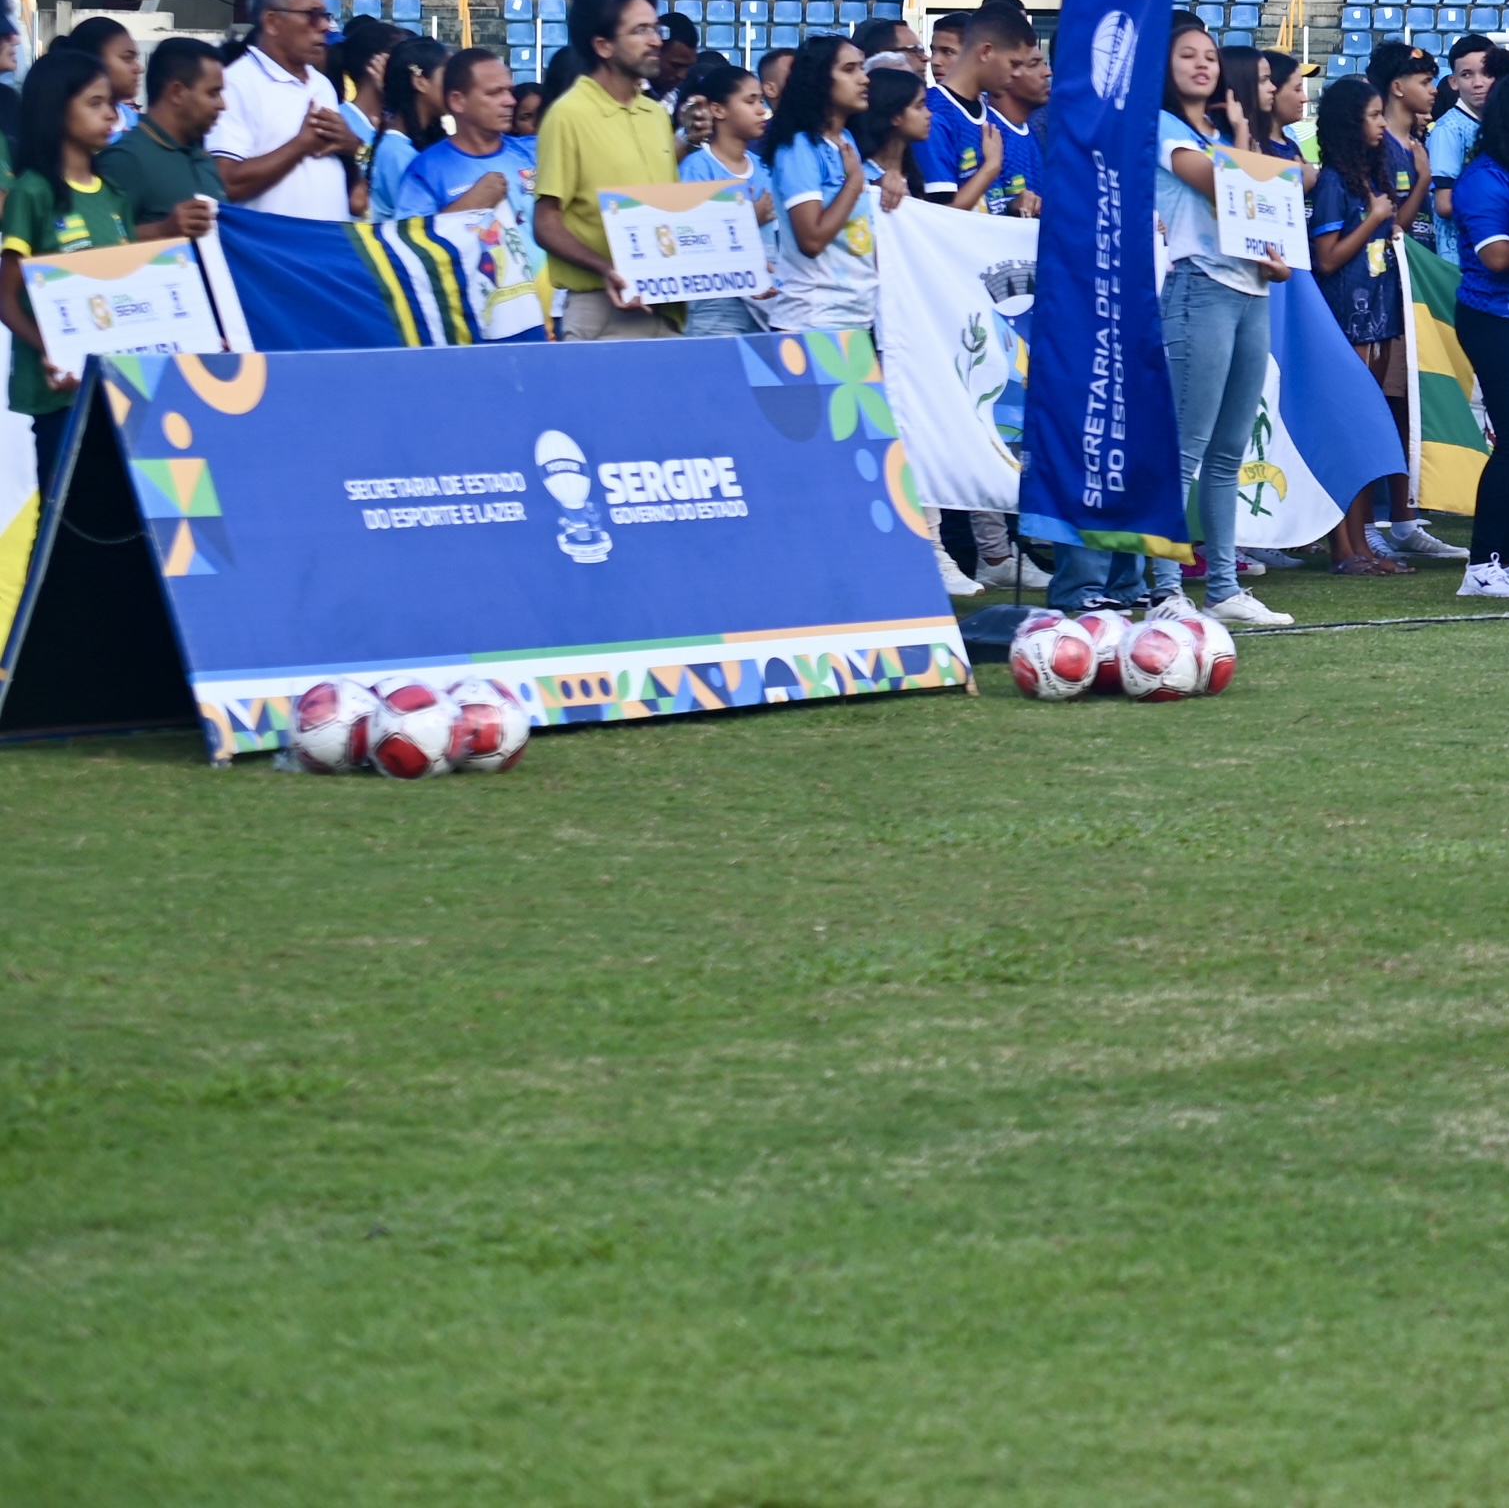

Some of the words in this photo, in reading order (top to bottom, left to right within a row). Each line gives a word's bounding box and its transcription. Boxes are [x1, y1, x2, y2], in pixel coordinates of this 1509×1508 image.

[1092, 150, 1110, 270] ESTADO
[1107, 168, 1122, 267] LAZER
[681, 270, 758, 293] REDONDO
[1096, 277, 1110, 319] DE
[1111, 302, 1126, 441] ESPORTE
[1083, 327, 1110, 509] SECRETARIA
[344, 476, 441, 501] SECRETARIA
[440, 474, 463, 496] DE
[463, 472, 527, 494] ESTADO
[598, 457, 743, 504] SERGIPE
[1107, 448, 1125, 492] DO
[362, 506, 393, 530] DO
[391, 504, 462, 528] ESPORTE
[461, 504, 473, 525] E
[471, 501, 527, 524] LAZER
[609, 503, 675, 525] GOVERNO
[674, 502, 698, 523] DO
[697, 500, 748, 520] ESTADO
